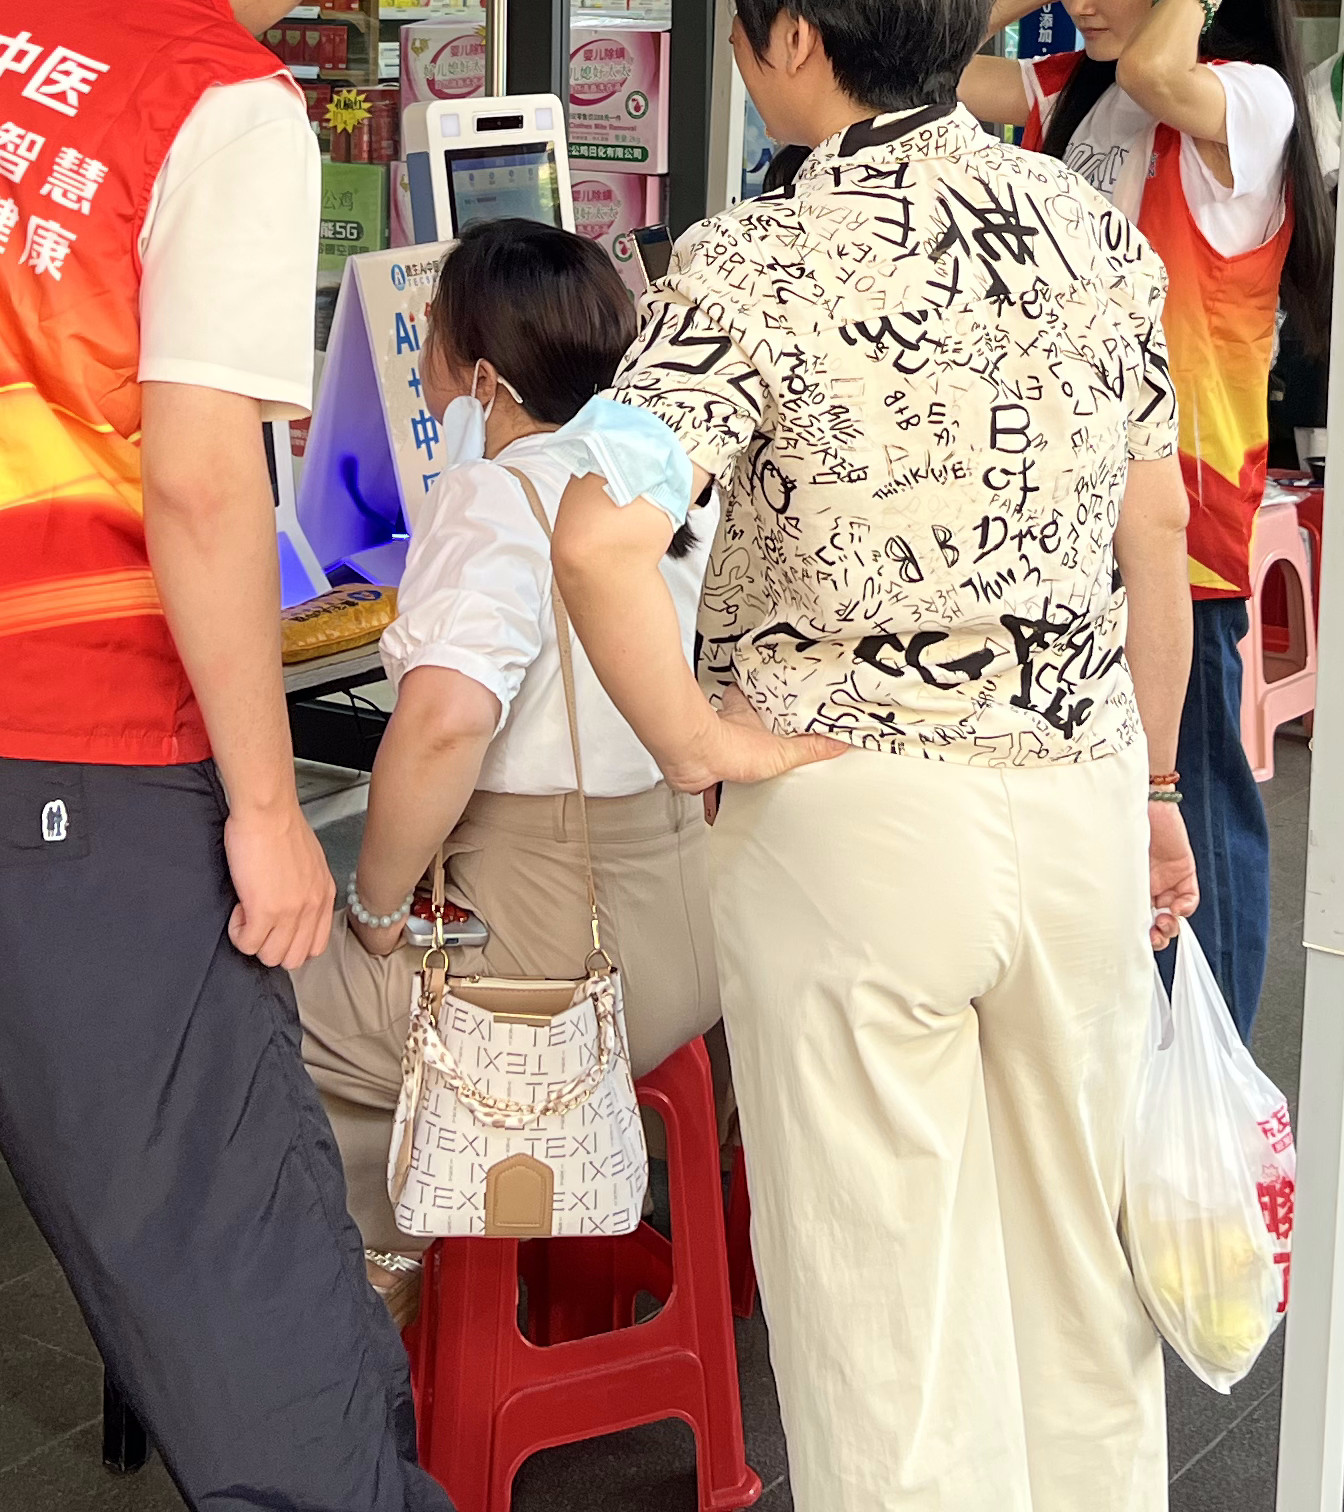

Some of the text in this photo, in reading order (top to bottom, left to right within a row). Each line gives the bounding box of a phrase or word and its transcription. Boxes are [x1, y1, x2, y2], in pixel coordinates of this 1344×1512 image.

[569, 145, 642, 160] 公鸡日化有限公司
